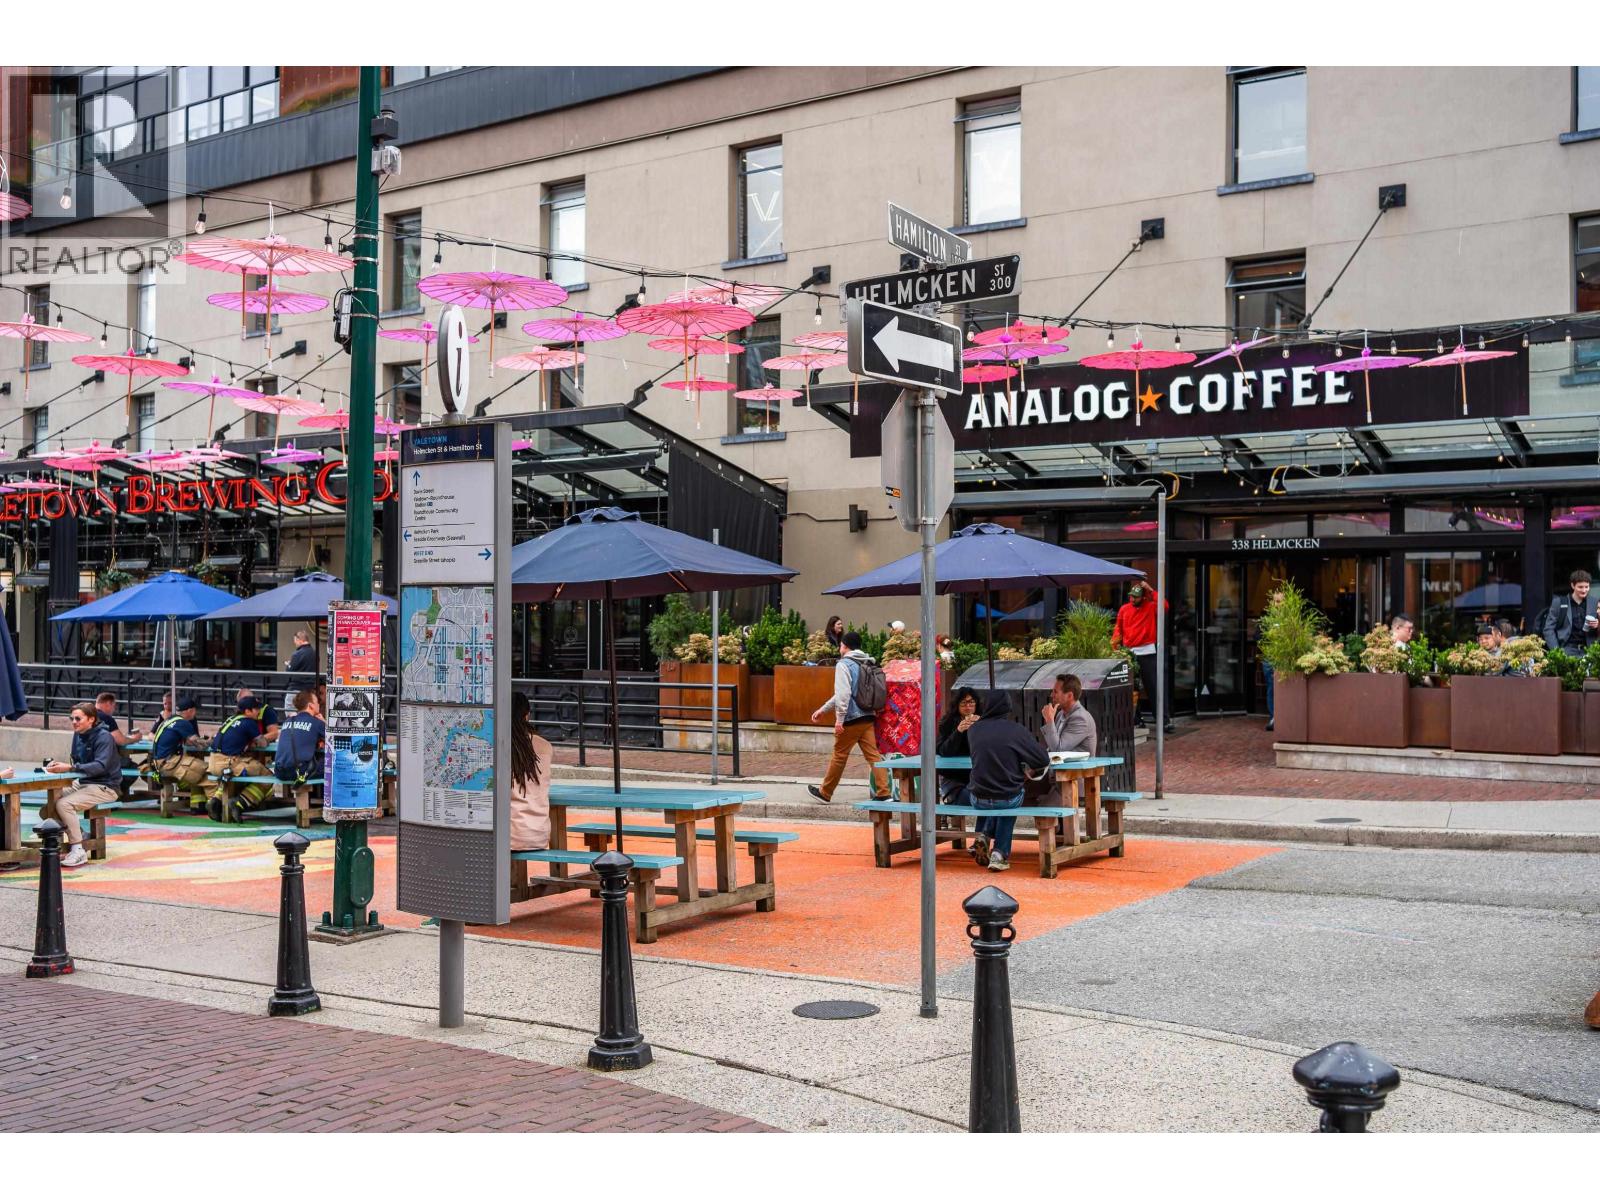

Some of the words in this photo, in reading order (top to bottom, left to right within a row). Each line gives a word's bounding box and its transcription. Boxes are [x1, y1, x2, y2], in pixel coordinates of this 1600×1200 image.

[895, 213, 947, 262] HAMILTON
[955, 244, 961, 257] ST
[855, 269, 977, 307] HELMCKEN
[994, 264, 1005, 277] ST
[989, 276, 1012, 292] 300
[963, 381, 1130, 430] ANALOG
[1169, 365, 1353, 416] COFFEE
[448, 444, 475, 452] Hamilton
[0, 486, 121, 521] ETOWN
[125, 475, 308, 513] BREWING
[1231, 540, 1250, 550] 338
[1252, 538, 1320, 550] HELMCKEN
